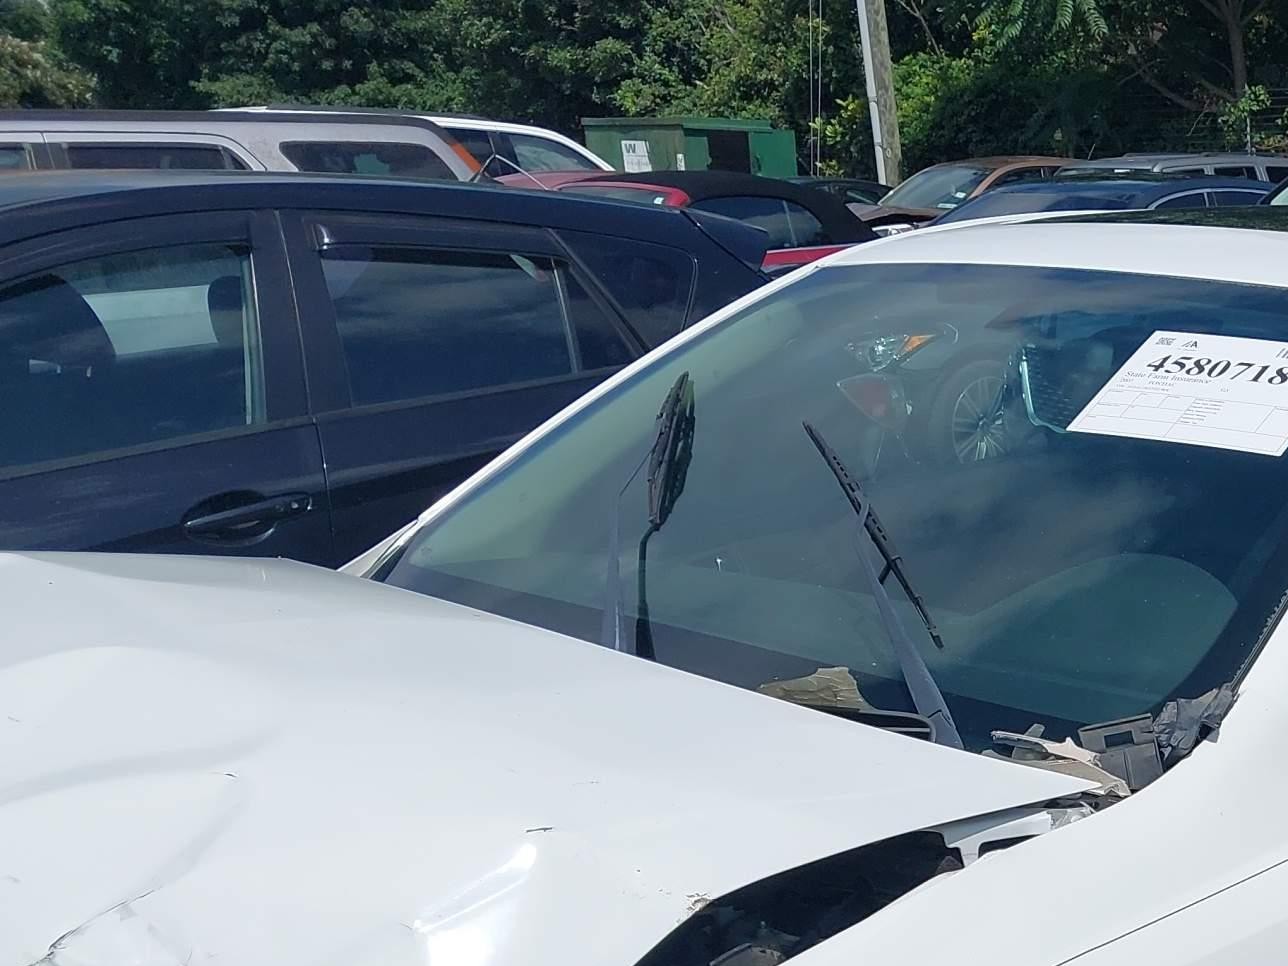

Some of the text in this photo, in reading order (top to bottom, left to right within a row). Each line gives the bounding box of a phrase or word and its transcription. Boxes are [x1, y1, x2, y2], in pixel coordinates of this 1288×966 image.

[1125, 370, 1212, 384] State Farm Insurance
